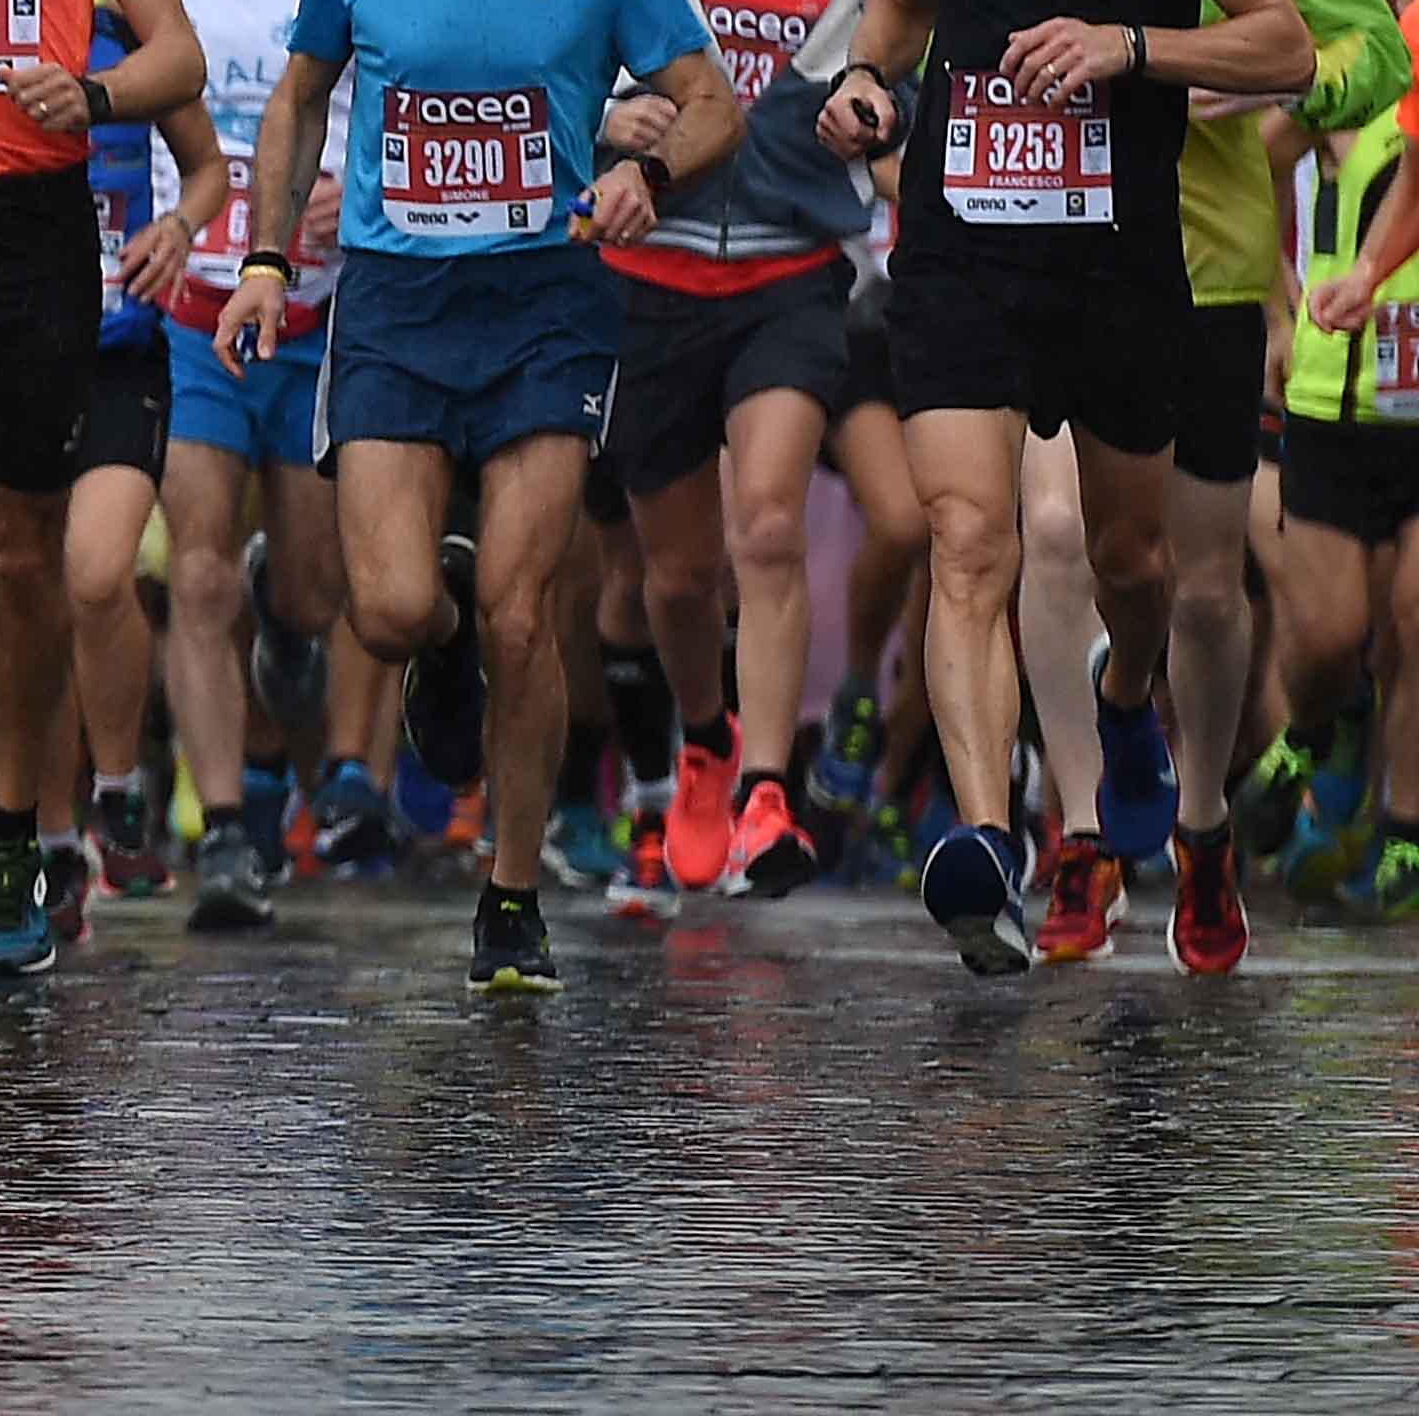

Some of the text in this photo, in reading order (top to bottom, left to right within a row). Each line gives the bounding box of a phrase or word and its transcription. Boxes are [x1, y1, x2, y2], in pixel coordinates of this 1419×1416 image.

[710, 6, 806, 43] acea
[963, 75, 1093, 105] 7 aa
[396, 91, 532, 124] 7 acea
[988, 122, 1064, 172] 3253
[423, 139, 505, 187] 3290
[441, 189, 491, 202] SIMONE
[988, 175, 1064, 188] FRANCESCO
[406, 211, 449, 225] arena
[966, 197, 1007, 211] arena
